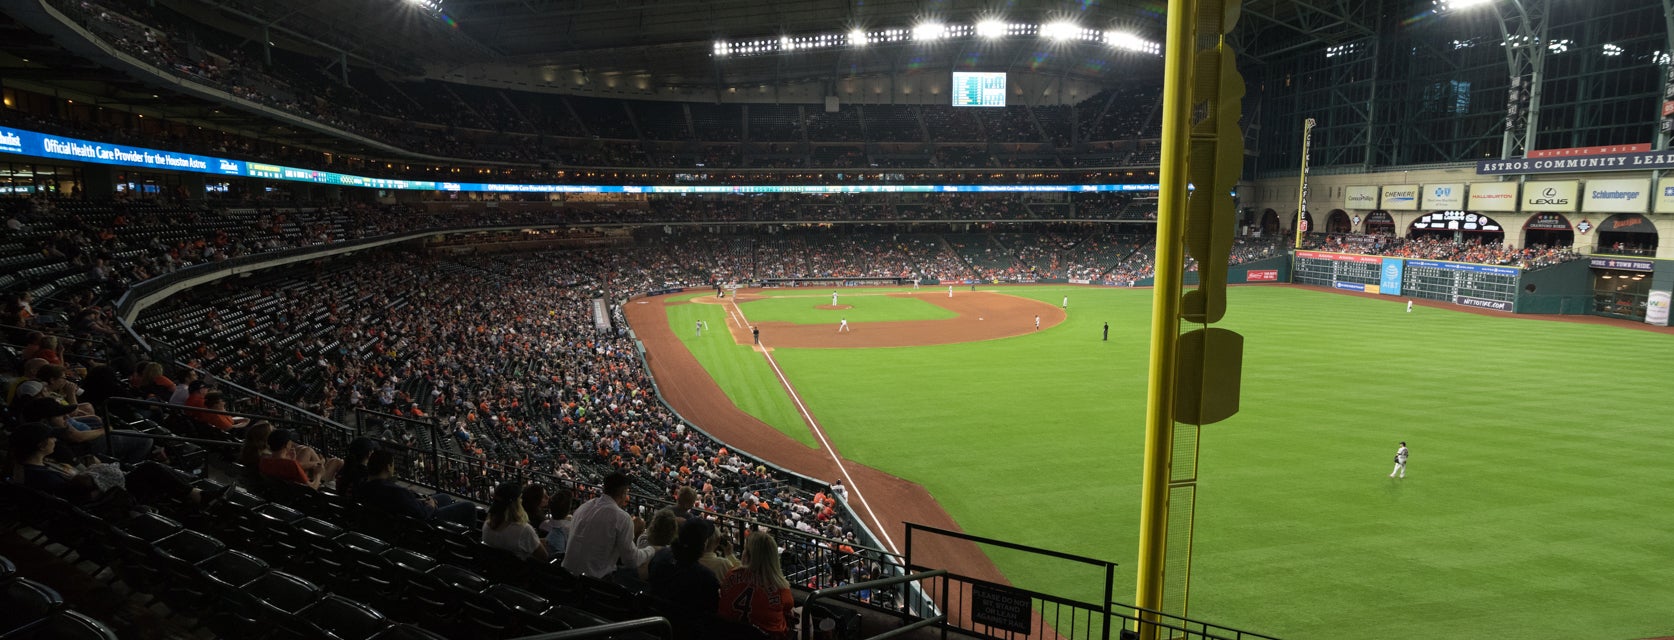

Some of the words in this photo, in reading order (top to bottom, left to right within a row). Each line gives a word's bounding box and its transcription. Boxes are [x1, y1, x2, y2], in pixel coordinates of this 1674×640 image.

[44, 138, 71, 155] Official
[71, 142, 95, 158] Health
[96, 146, 114, 160] Care
[114, 148, 143, 163] Provider
[144, 151, 155, 164] for
[155, 153, 165, 165] the
[166, 155, 188, 167] Houston
[189, 157, 206, 169] Astros
[1483, 161, 1529, 171] ASTROS
[1534, 156, 1627, 169] COMMUNITY
[1592, 190, 1639, 200] Schlumberger
[732, 585, 755, 622] 4
